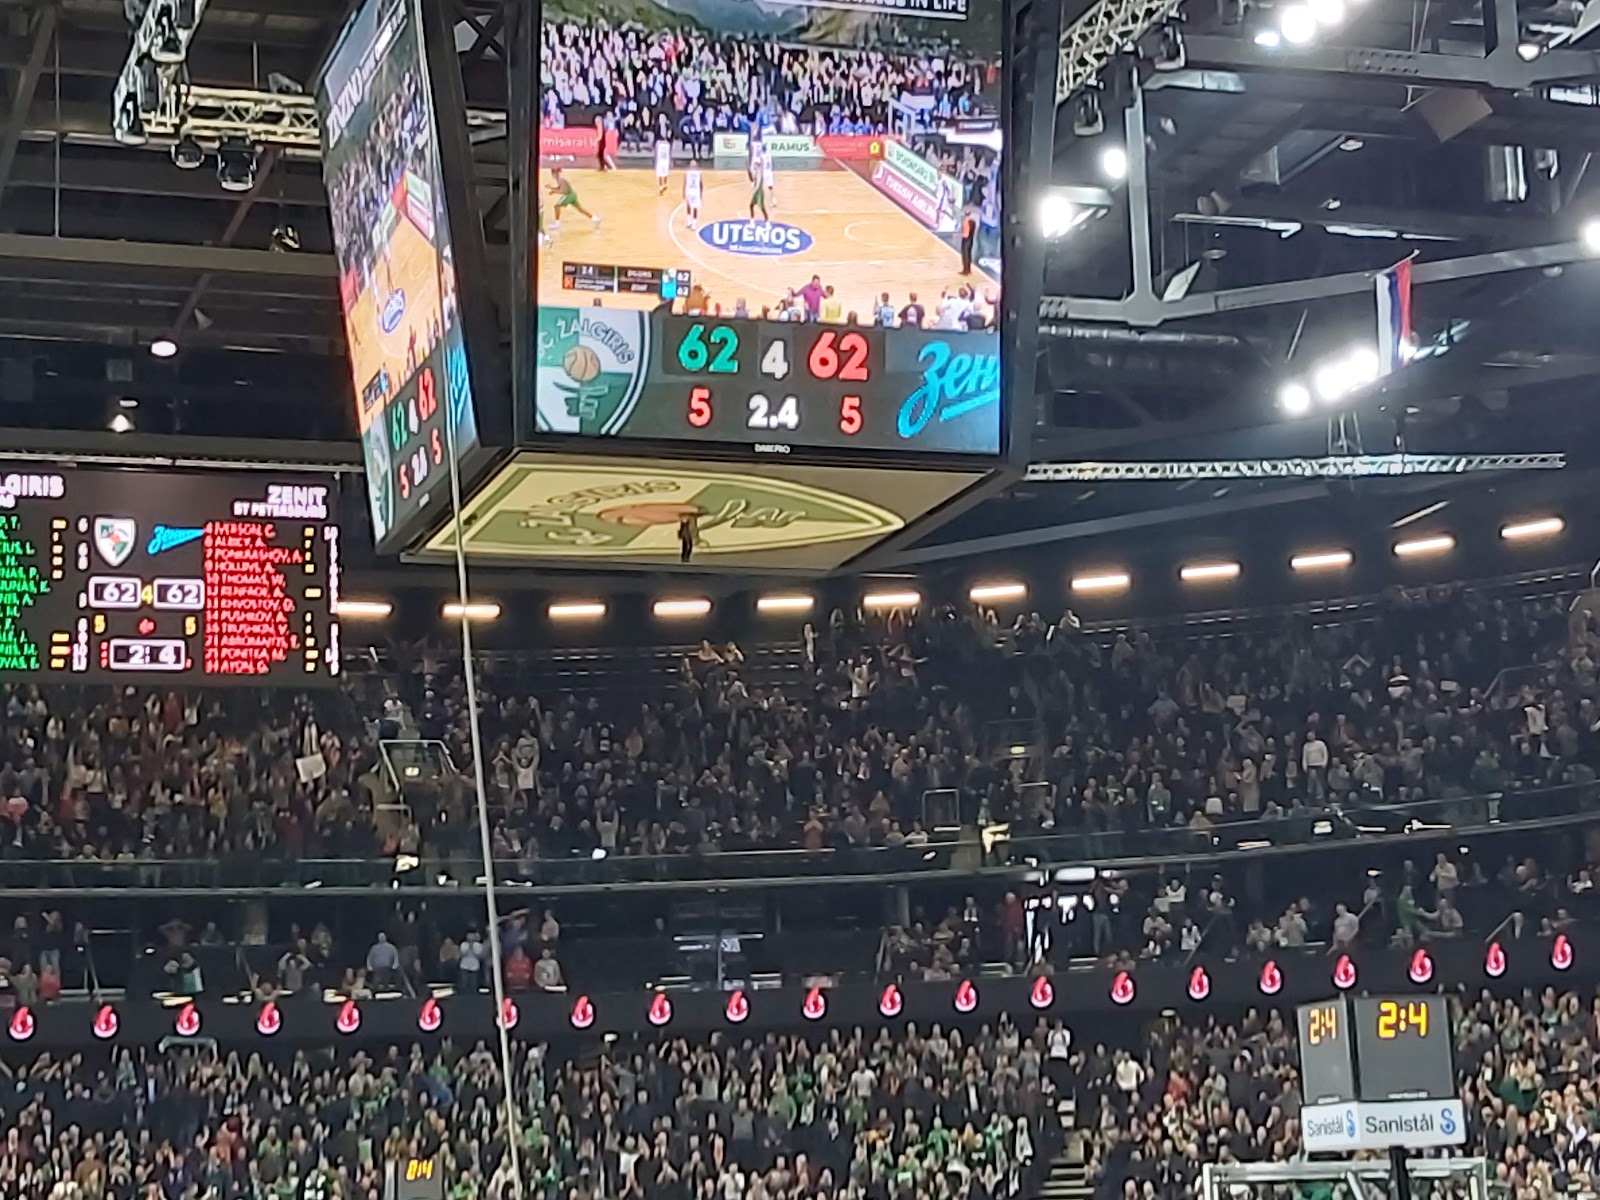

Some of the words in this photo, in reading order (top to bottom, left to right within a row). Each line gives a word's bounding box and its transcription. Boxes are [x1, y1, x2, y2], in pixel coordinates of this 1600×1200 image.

[713, 222, 801, 251] UTENOS
[678, 324, 739, 374] 62
[761, 340, 789, 380] 4
[809, 332, 869, 381] 62
[687, 386, 713, 428] 5
[747, 394, 799, 431] 2.4
[839, 396, 863, 434] 5
[267, 485, 328, 505] ZENIT
[103, 582, 136, 603] 62
[141, 584, 153, 605] 4
[166, 583, 199, 604] 62
[1309, 1006, 1337, 1045] 2:4
[1378, 1001, 1428, 1039] 2:4
[1365, 1112, 1435, 1135] Sanistål
